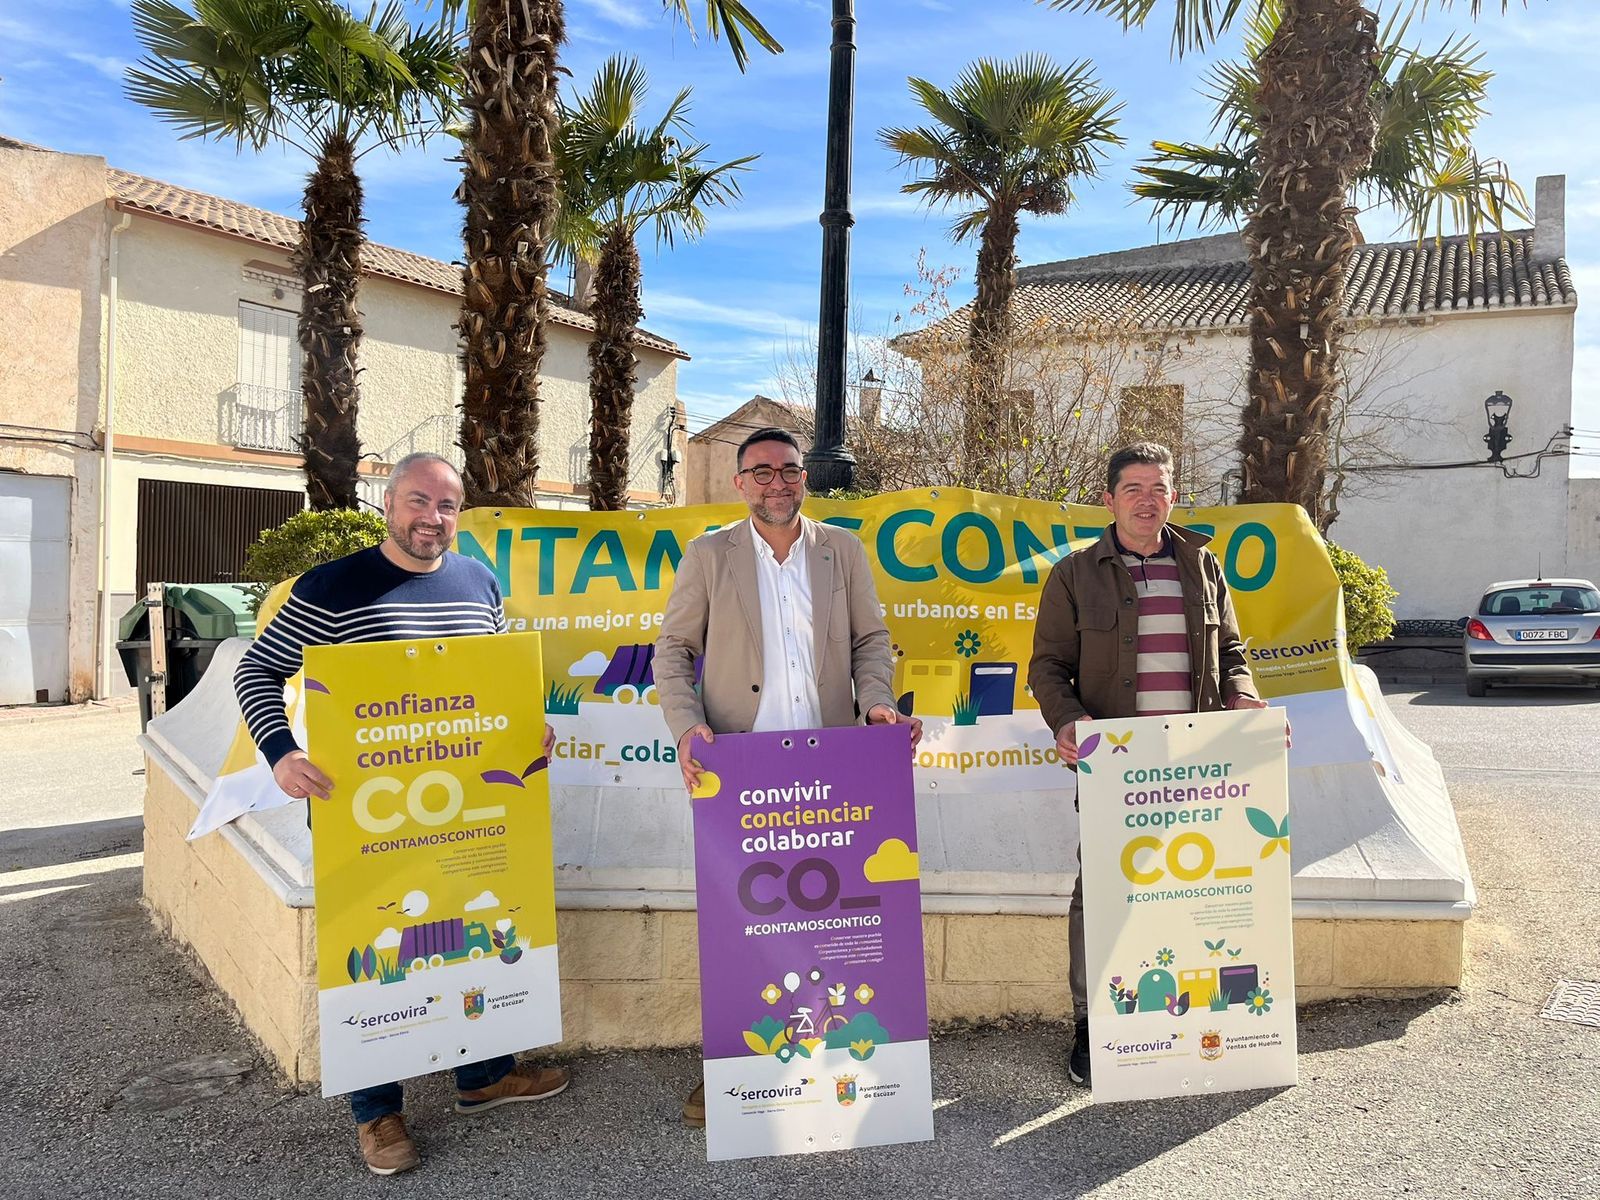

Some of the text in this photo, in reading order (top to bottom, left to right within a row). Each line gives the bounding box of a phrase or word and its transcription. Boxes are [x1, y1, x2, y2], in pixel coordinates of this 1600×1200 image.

[893, 599, 979, 619] urbanos
[985, 604, 1008, 620] en
[506, 617, 526, 631] ra
[533, 616, 568, 631] una
[575, 610, 634, 632] mejor
[1522, 630, 1564, 639] 0072 FBC
[354, 693, 476, 719] confianza
[355, 711, 509, 744] compromiso
[357, 736, 483, 769] contribuir
[554, 736, 677, 766] ciar_cola
[913, 743, 1068, 774] ompromiso
[1123, 762, 1232, 784] conservar
[739, 780, 832, 806] convivir
[1124, 780, 1250, 806] contenedor
[740, 801, 873, 830] concienciar
[1124, 807, 1223, 829] cooperar
[360, 825, 506, 855] #CONTAMOSCONTIGO
[741, 828, 854, 853] colaborar
[1126, 884, 1253, 903] #CONTAMOSCONTIGO
[744, 915, 882, 936] #CONTAMOSCONTIGO
[487, 989, 529, 1004] Ayuntamiento
[492, 997, 525, 1010] de Escúzar
[360, 1004, 428, 1029] sercovira
[1116, 1039, 1172, 1054] sercovira
[1225, 1034, 1270, 1044] Ayuntamiento
[1225, 1039, 1282, 1050] Ventas de Huelma
[741, 1085, 802, 1101] sercovira
[859, 1082, 901, 1092] Ayuntamiento
[873, 1089, 896, 1098] Escúzar
